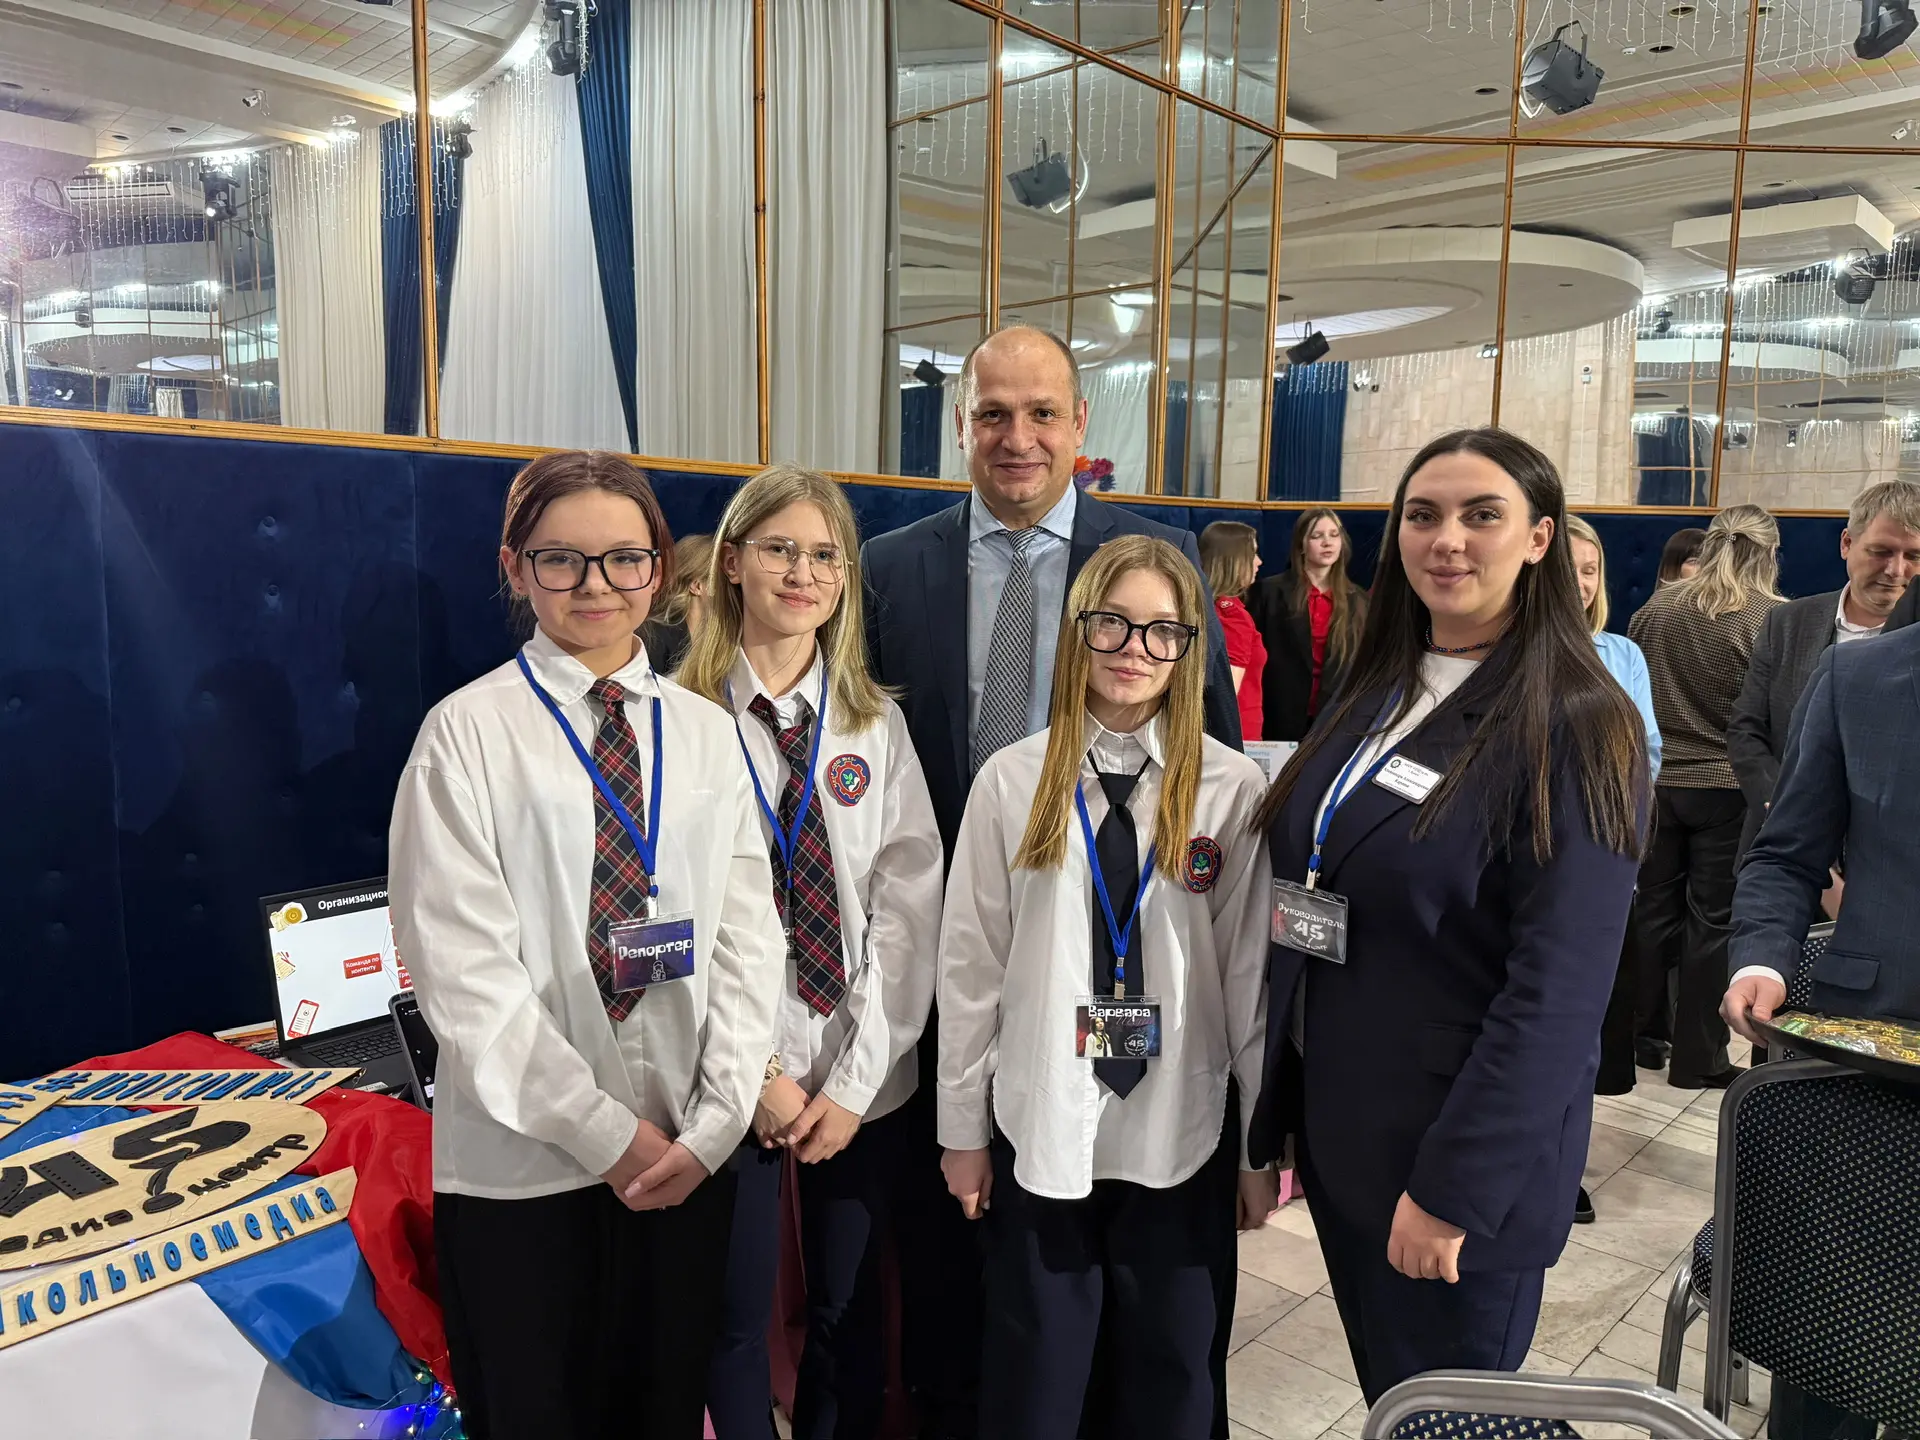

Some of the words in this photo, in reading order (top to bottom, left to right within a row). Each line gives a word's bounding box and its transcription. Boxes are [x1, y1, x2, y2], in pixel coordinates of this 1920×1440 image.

[1278, 902, 1345, 930] Руководитель
[1293, 919, 1326, 941] 45
[618, 939, 693, 961] Репортер
[1088, 1005, 1151, 1022] Варвара
[1128, 1039, 1145, 1047] 45
[188, 1133, 309, 1197] центр
[0, 1186, 337, 1336] кольноемедиа
